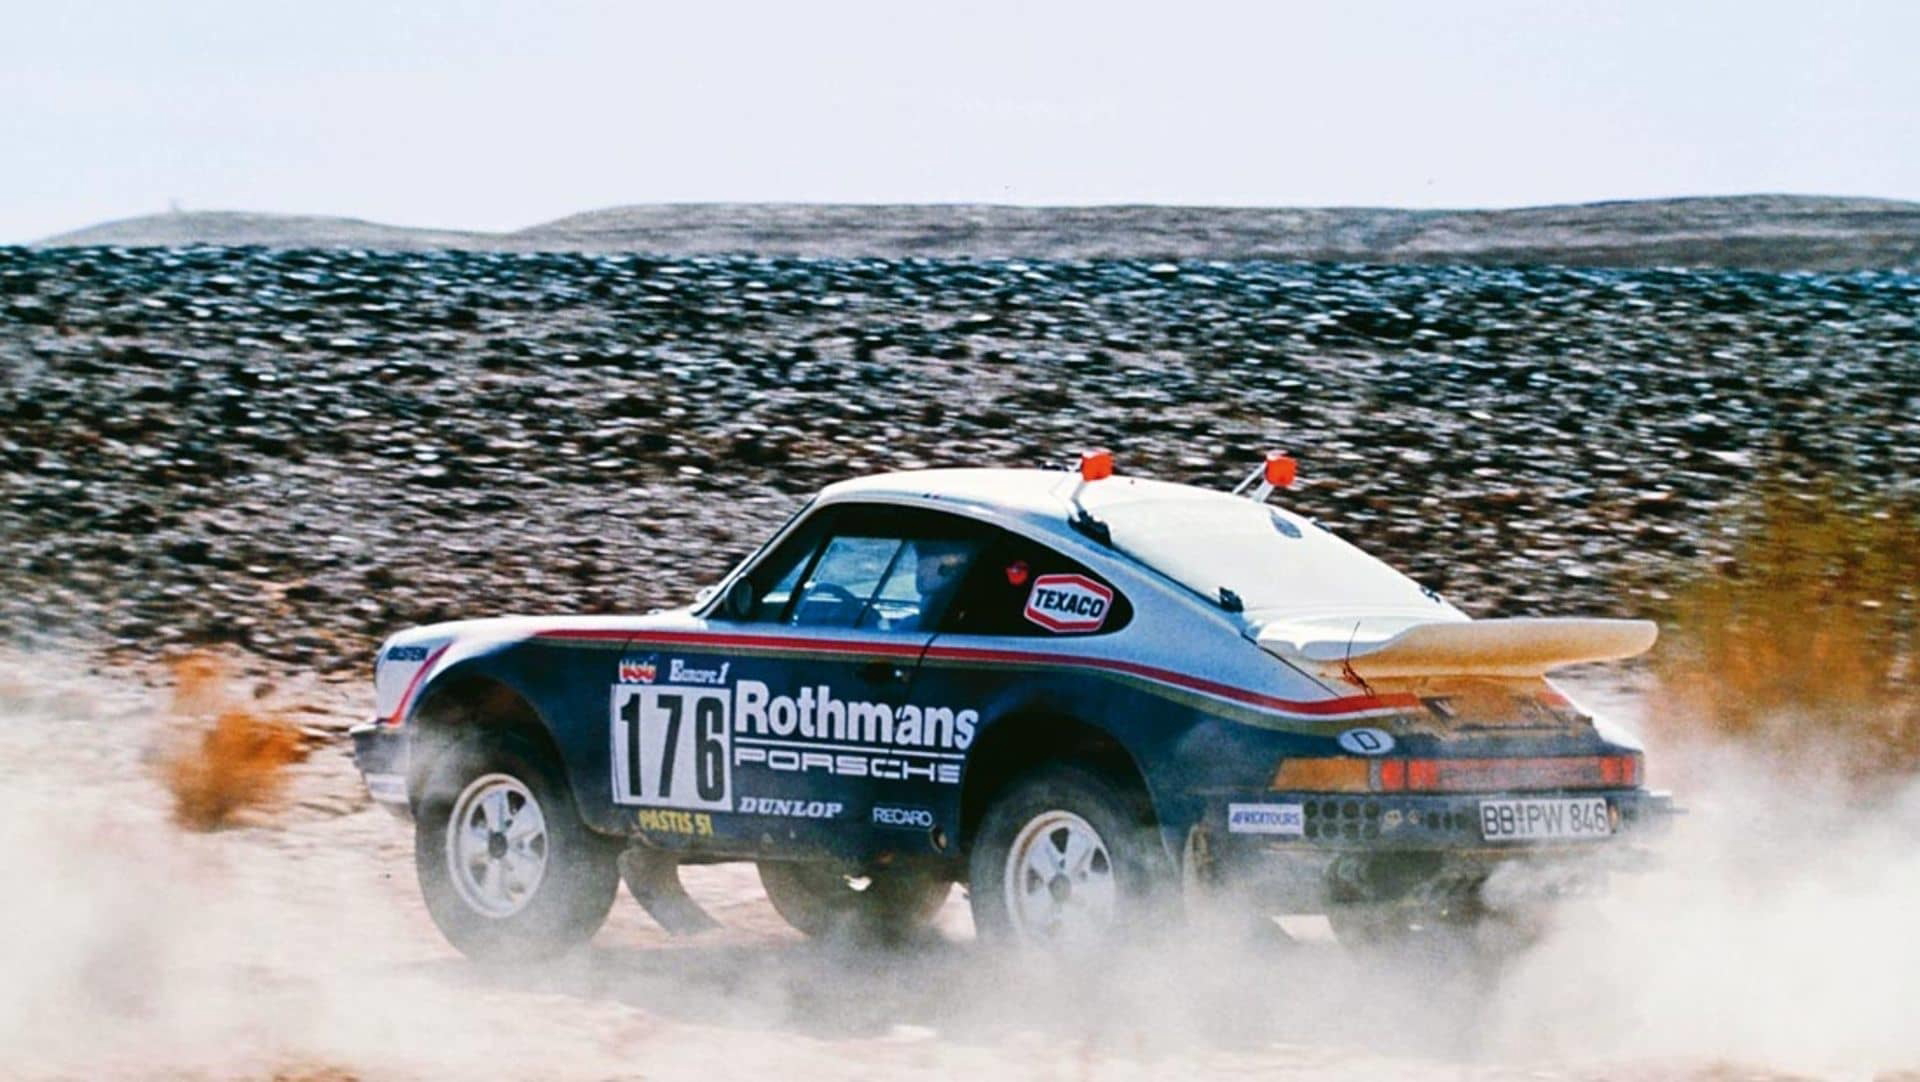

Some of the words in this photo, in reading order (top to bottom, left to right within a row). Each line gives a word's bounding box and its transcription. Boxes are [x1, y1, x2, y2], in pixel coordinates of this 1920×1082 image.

[1034, 589, 1104, 618] TEXACO
[735, 680, 979, 750] Rothmans
[620, 693, 725, 803] 176
[1351, 730, 1381, 750] D
[735, 747, 961, 783] PORSCHE
[639, 809, 694, 834] PASTIS
[738, 796, 843, 818] DUNLOP
[873, 806, 933, 827] RECARO
[1526, 803, 1564, 833] PW
[1569, 803, 1606, 833] 846
